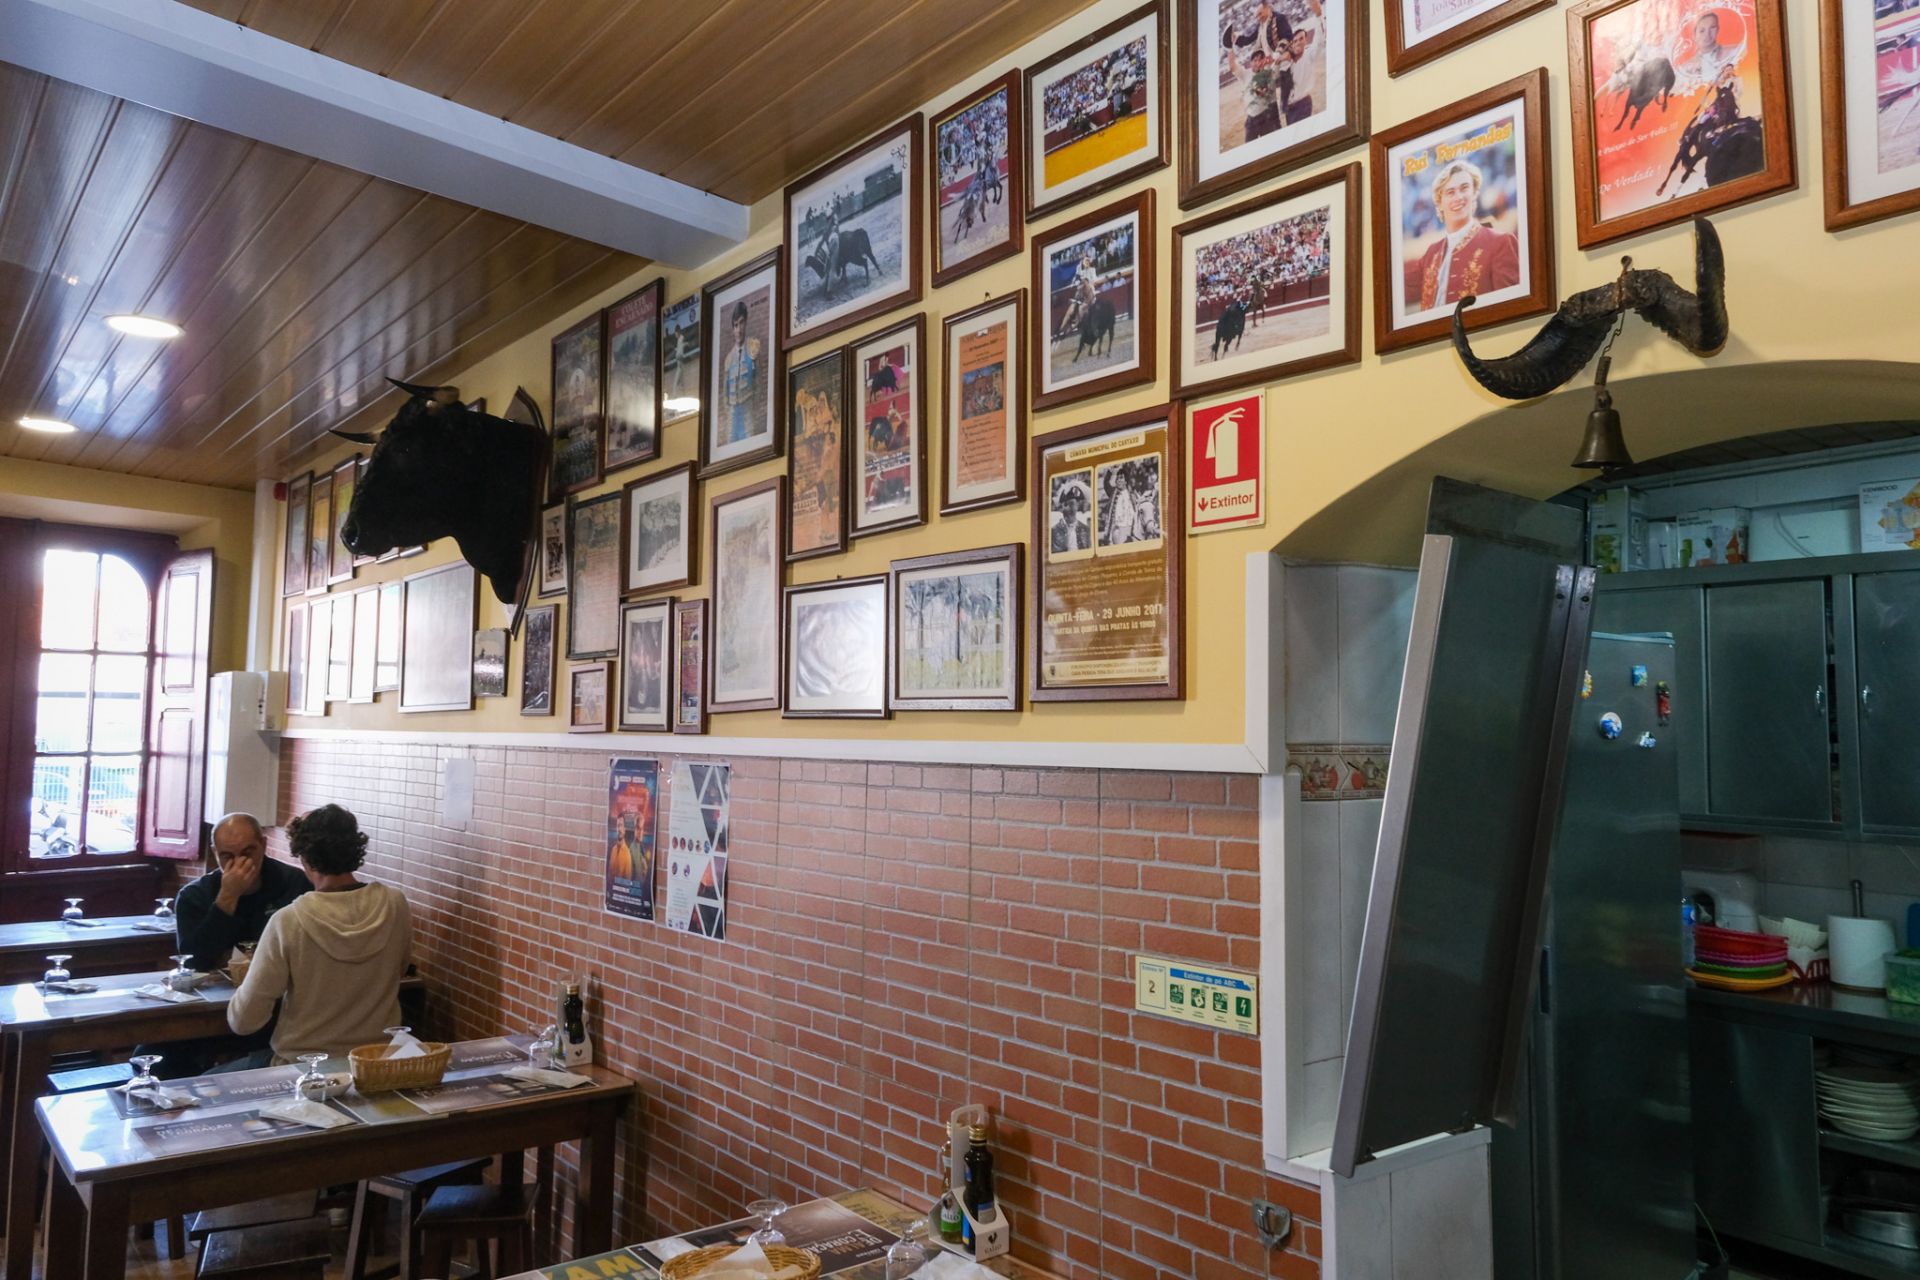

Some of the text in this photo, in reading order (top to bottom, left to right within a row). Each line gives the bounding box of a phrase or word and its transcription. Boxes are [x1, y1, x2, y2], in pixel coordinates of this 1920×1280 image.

[1403, 121, 1514, 177] Rui Fernandes
[1210, 493, 1254, 509] Extintor
[1102, 607, 1113, 619] 29
[1115, 605, 1141, 618] JUNHO
[1148, 980, 1156, 994] 2
